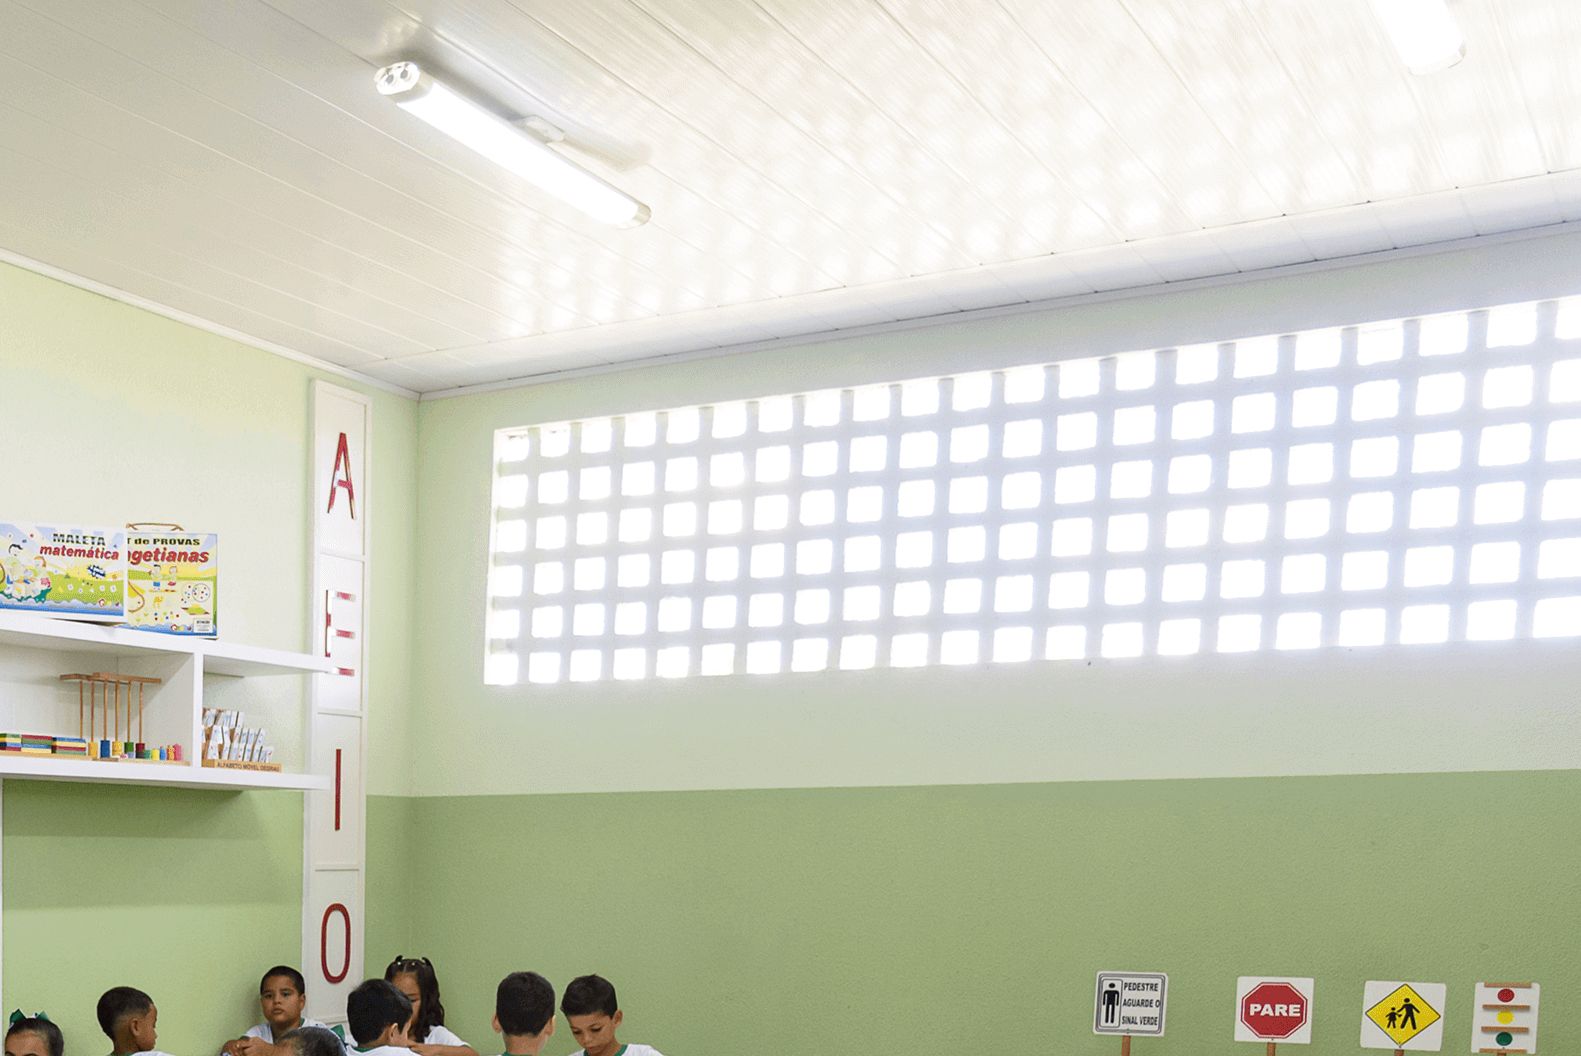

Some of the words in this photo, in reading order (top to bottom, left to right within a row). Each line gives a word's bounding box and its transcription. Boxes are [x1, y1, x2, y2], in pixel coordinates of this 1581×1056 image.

[327, 432, 356, 520] A
[53, 533, 106, 546] MALETA
[153, 538, 201, 546] PROVAS
[39, 545, 119, 560] matemática
[326, 589, 355, 676] E
[334, 748, 341, 831] I
[321, 902, 351, 984] O
[1123, 982, 1159, 992] PEDESTRE
[1122, 999, 1153, 1008] AGUARDE
[1155, 1000, 1161, 1008] O
[1249, 1003, 1301, 1018] PARE
[1122, 1016, 1138, 1025] SINAL
[1139, 1016, 1158, 1025] VERDE
